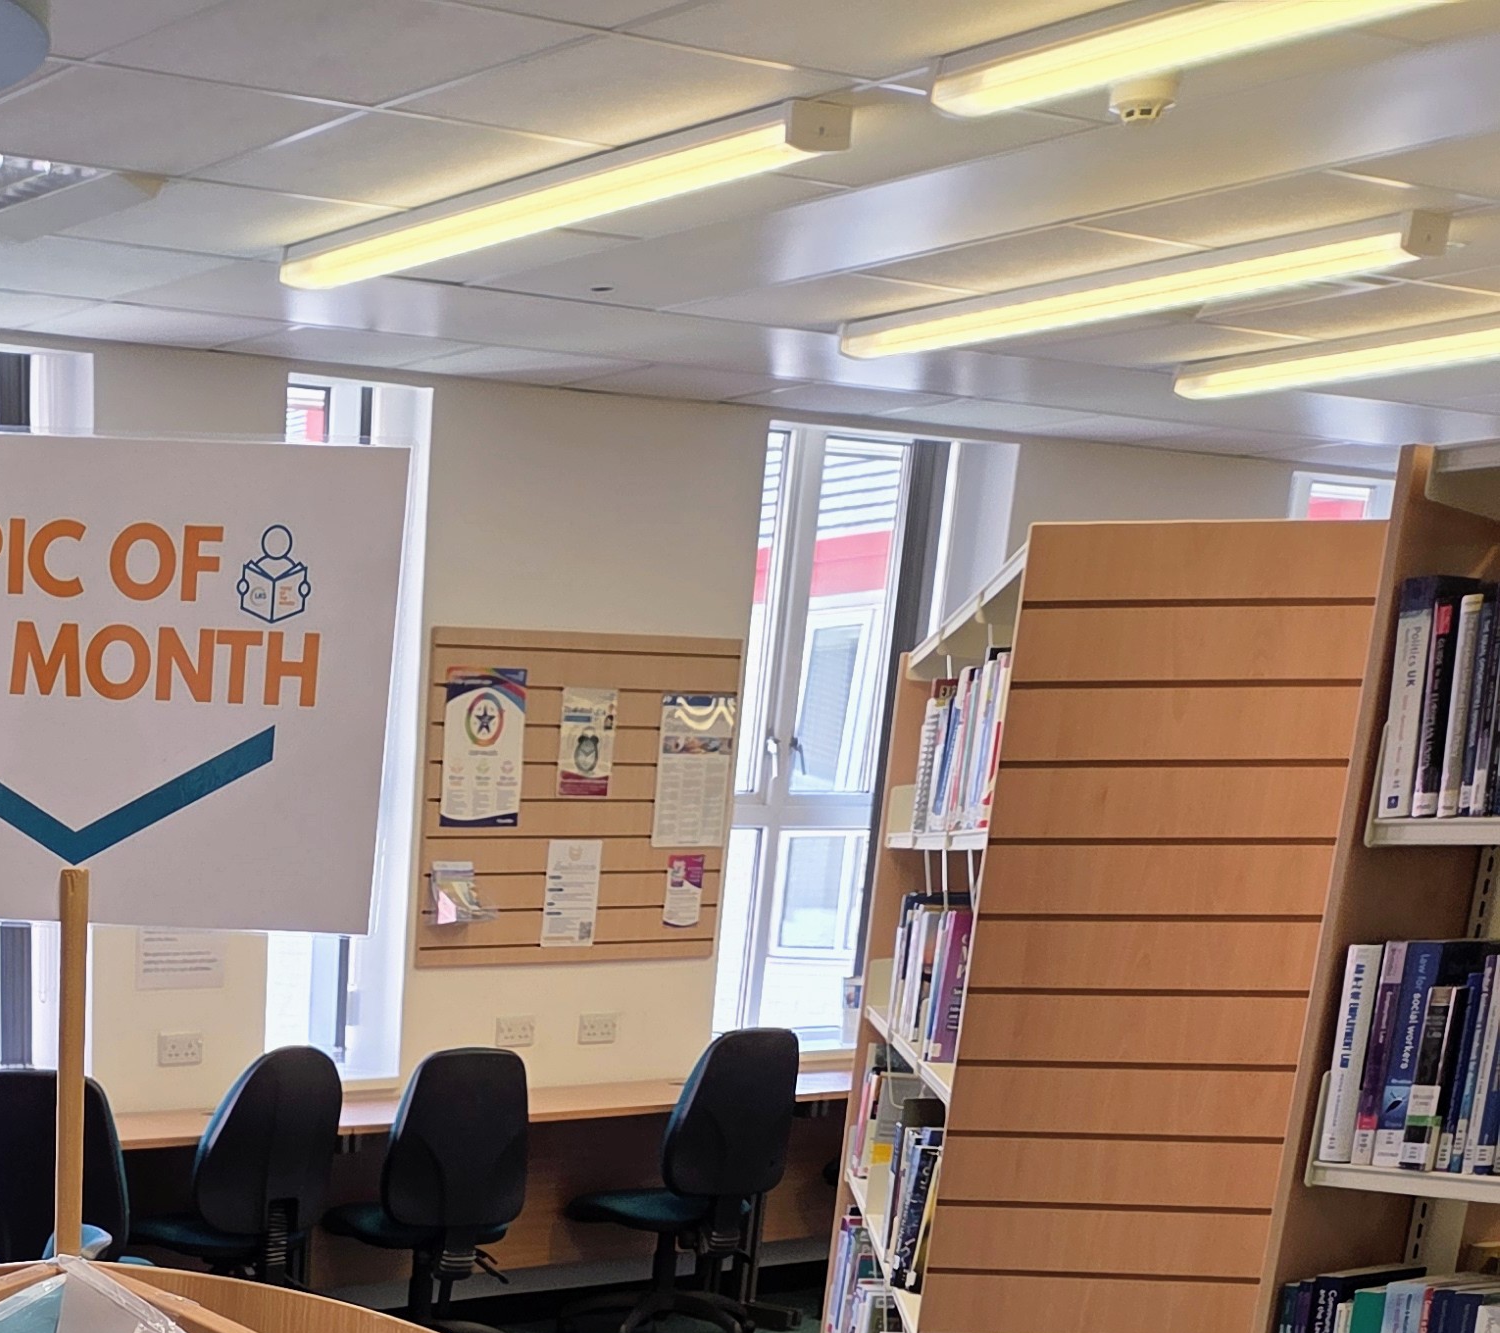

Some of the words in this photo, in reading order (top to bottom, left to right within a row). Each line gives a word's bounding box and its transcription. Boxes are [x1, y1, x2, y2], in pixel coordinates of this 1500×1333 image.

[109, 522, 224, 602] OF
[9, 621, 320, 707] MONTH
[1405, 671, 1417, 687] UK
[1409, 993, 1421, 1024] social
[1400, 1026, 1418, 1070] workers
